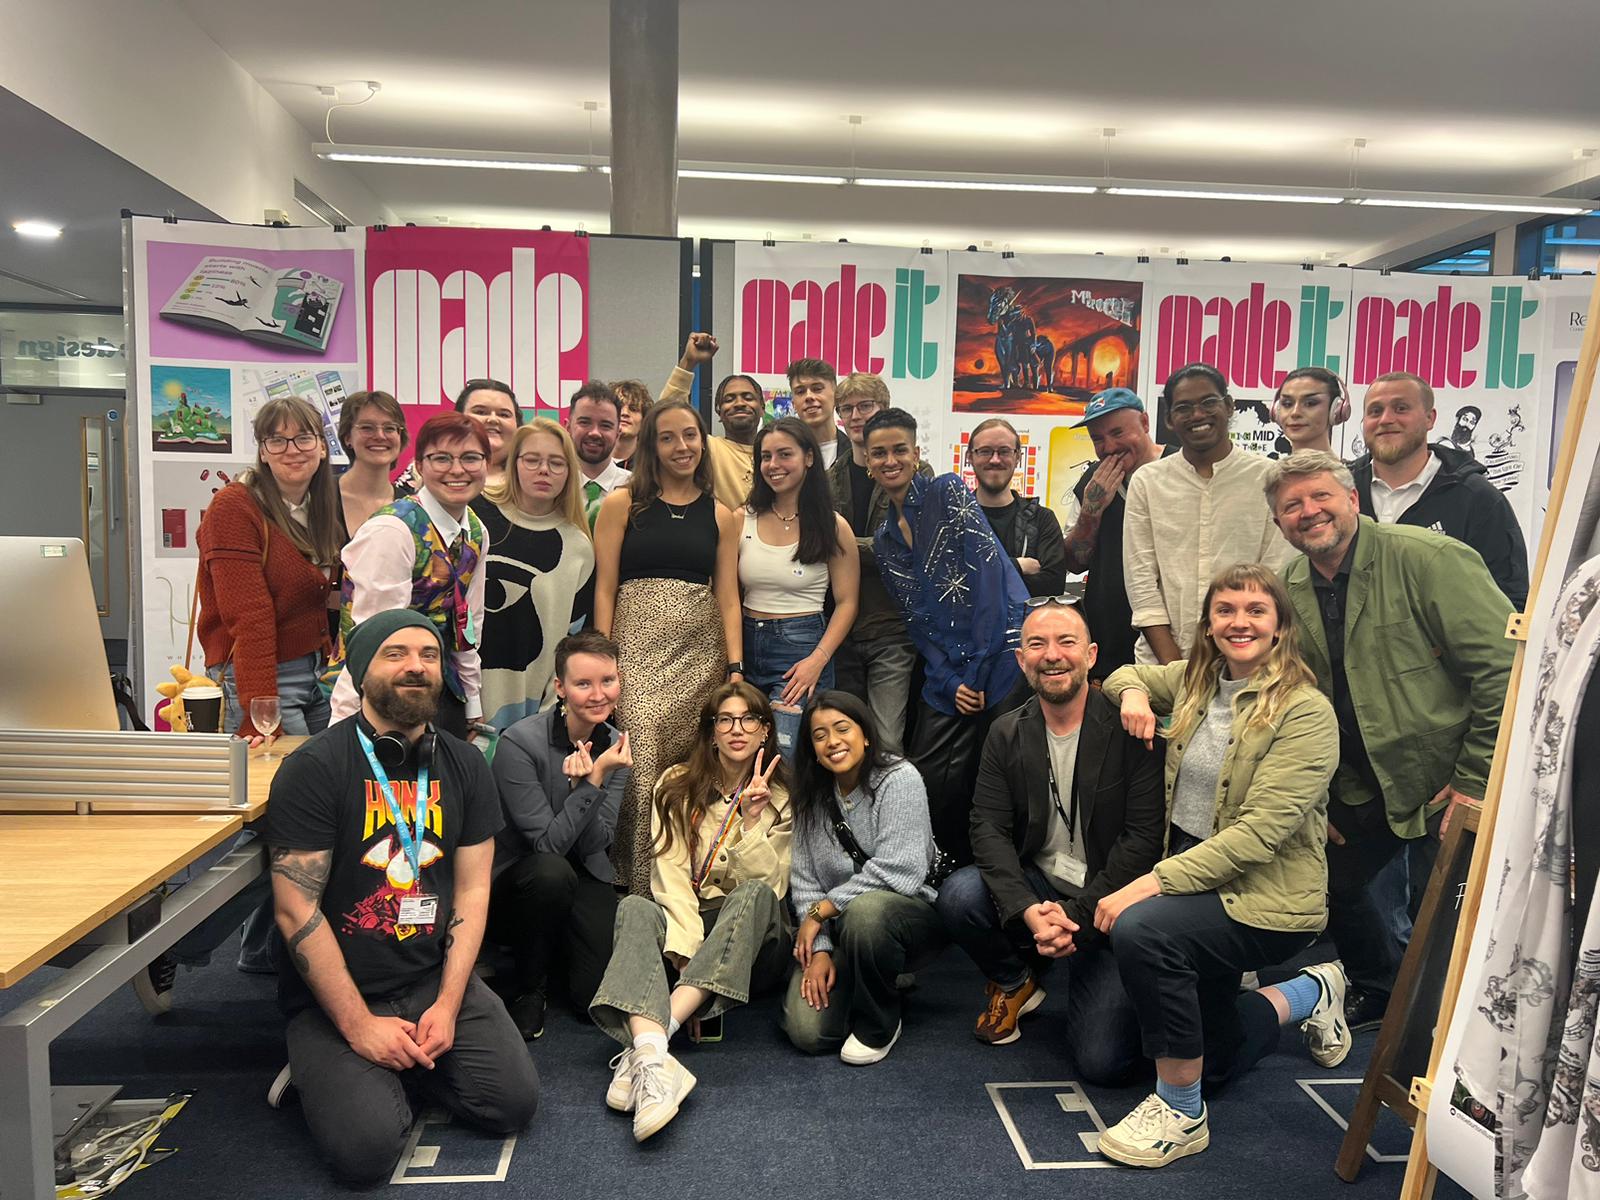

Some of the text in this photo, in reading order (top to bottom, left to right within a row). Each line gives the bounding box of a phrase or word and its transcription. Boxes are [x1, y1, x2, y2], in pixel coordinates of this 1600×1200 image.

[373, 247, 583, 408] made
[741, 264, 940, 379] made it
[1155, 282, 1344, 389] made it
[1353, 286, 1539, 389] made it
[1252, 430, 1275, 441] MID
[362, 779, 443, 841] HONK
